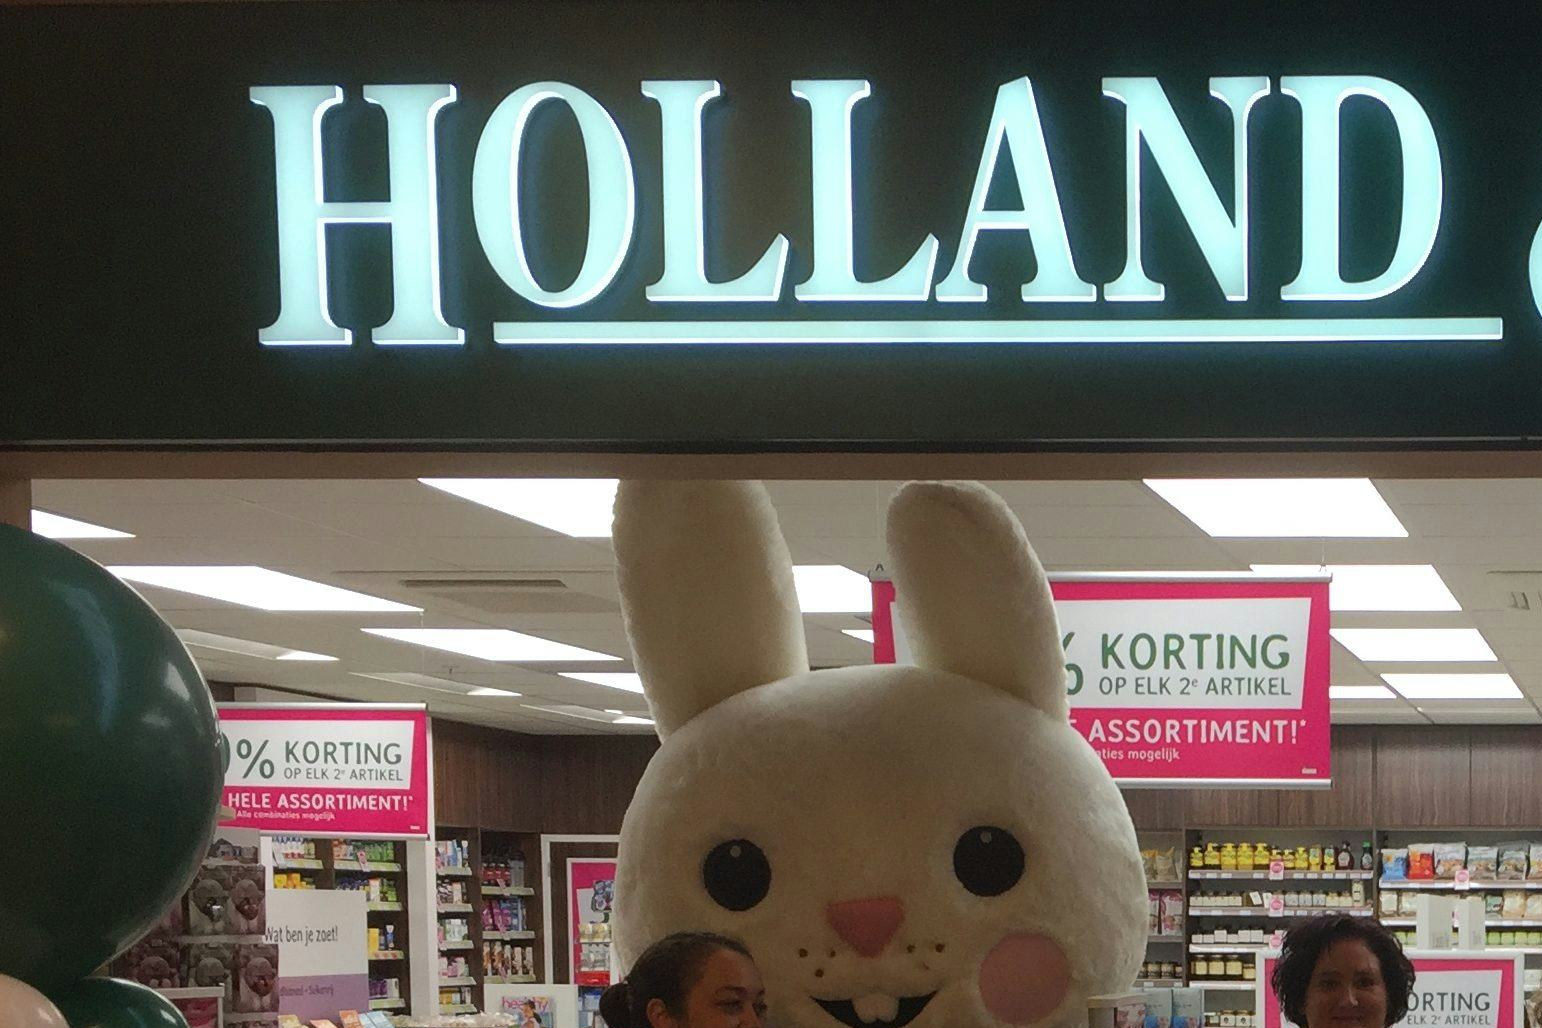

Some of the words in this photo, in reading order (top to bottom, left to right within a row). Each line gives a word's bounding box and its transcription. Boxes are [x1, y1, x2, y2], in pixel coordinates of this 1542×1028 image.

[250, 75, 1444, 346] HOLLAND
[1101, 633, 1290, 670] KORTING
[1099, 677, 1127, 696] OP
[1135, 677, 1171, 696] ELK
[1205, 677, 1292, 696] ARTIKEL
[285, 740, 401, 765] KORTING
[1127, 747, 1180, 763] mogelijk
[284, 767, 302, 779] OP
[306, 767, 329, 780] ELK
[350, 768, 403, 781] ARTIKEL
[228, 792, 271, 809] HELE
[253, 811, 300, 820] combinaties
[301, 811, 335, 821] mogelijk
[265, 926, 283, 942] Wat
[285, 925, 303, 942] ben
[305, 926, 314, 946] je
[1406, 992, 1490, 1012] ORTING
[1407, 1015, 1425, 1025] ELK
[1445, 1015, 1490, 1025] ARTIKEL
